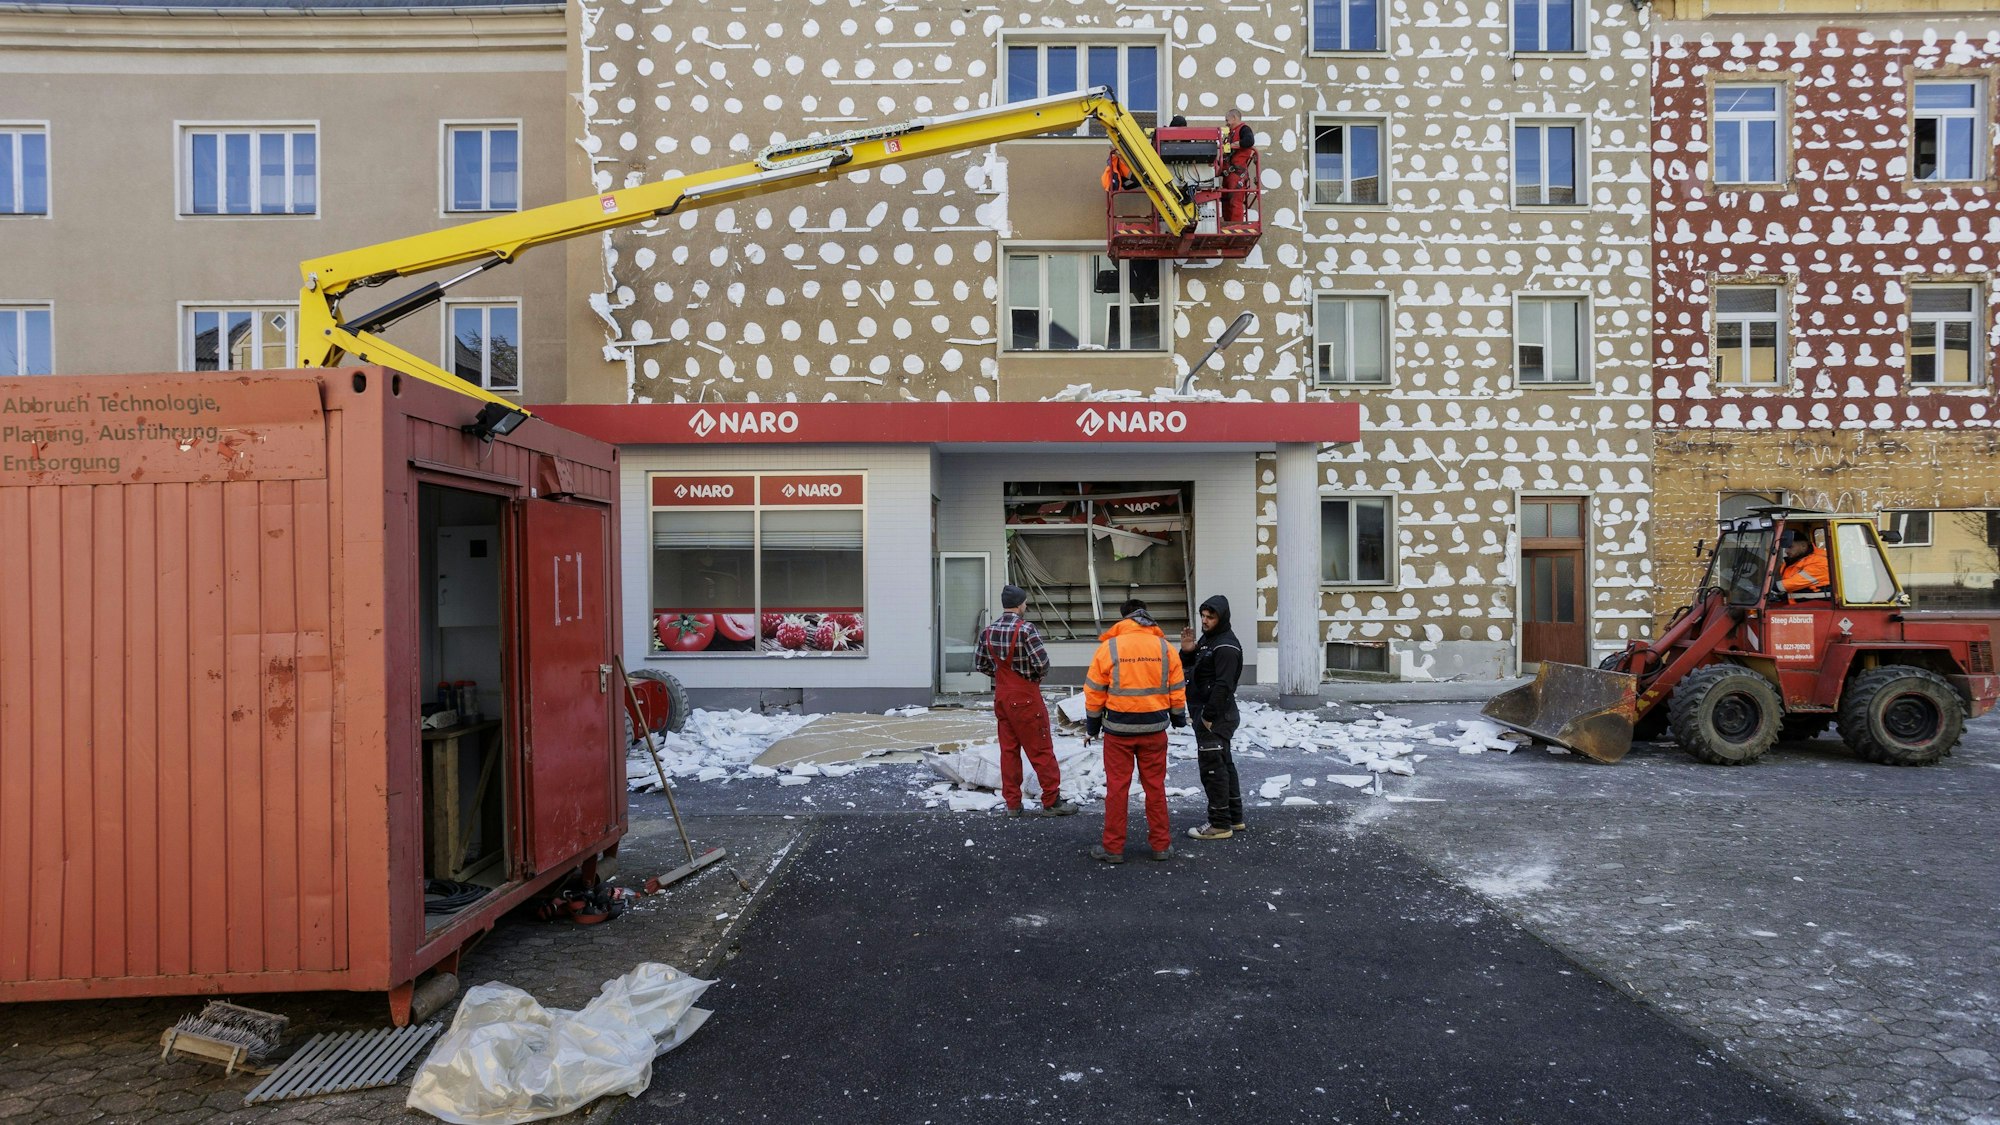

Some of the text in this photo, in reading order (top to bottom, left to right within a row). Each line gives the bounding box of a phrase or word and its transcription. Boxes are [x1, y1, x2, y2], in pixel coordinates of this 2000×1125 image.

[3, 393, 220, 415] Abbruch Technologie,
[720, 411, 799, 433] NARO
[1107, 411, 1187, 433] NARO
[3, 422, 223, 446] Planung, Ausführung,
[3, 455, 120, 475] Entsorgung
[689, 484, 734, 498] NARO
[797, 483, 842, 497] NARO
[1771, 616, 1813, 625] Steeg Abbruch
